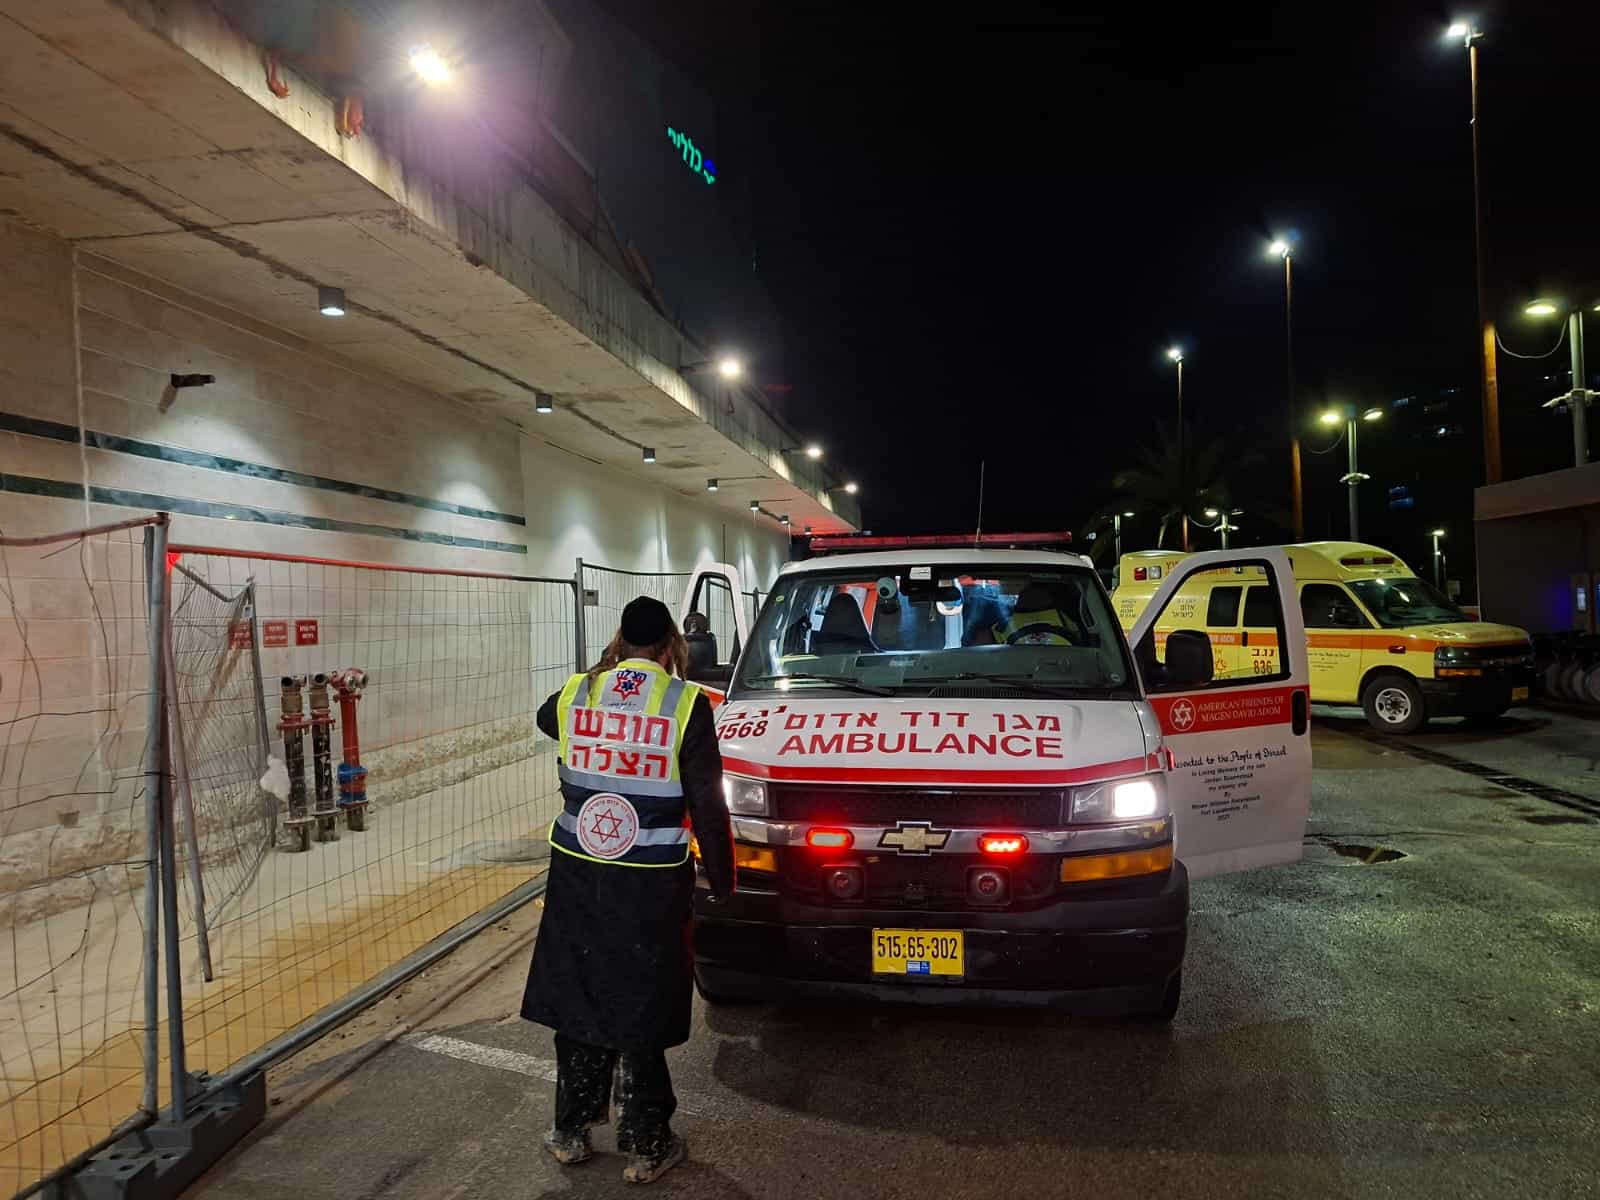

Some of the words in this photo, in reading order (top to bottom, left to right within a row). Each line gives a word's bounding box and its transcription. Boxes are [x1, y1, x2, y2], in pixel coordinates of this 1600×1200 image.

[667, 126, 703, 173] כללית
[616, 669, 648, 682] הצלה
[1253, 660, 1273, 674] 836
[1197, 703, 1240, 712] AMERICAN
[1241, 698, 1273, 707] FRIENDS
[1274, 696, 1284, 704] OF
[783, 712, 878, 729] אדום
[900, 711, 969, 727] דוד
[1200, 712, 1231, 722] MAGEN
[1232, 709, 1257, 720] DAVID
[1257, 706, 1281, 715] ADOM
[574, 708, 669, 747] חובש
[718, 720, 769, 740] 1568
[992, 714, 1060, 732] מגן
[777, 733, 1064, 758] AMBULANCE
[572, 744, 667, 778] הצלה
[1206, 756, 1215, 765] to
[1218, 753, 1229, 763] the
[1230, 750, 1252, 763] People
